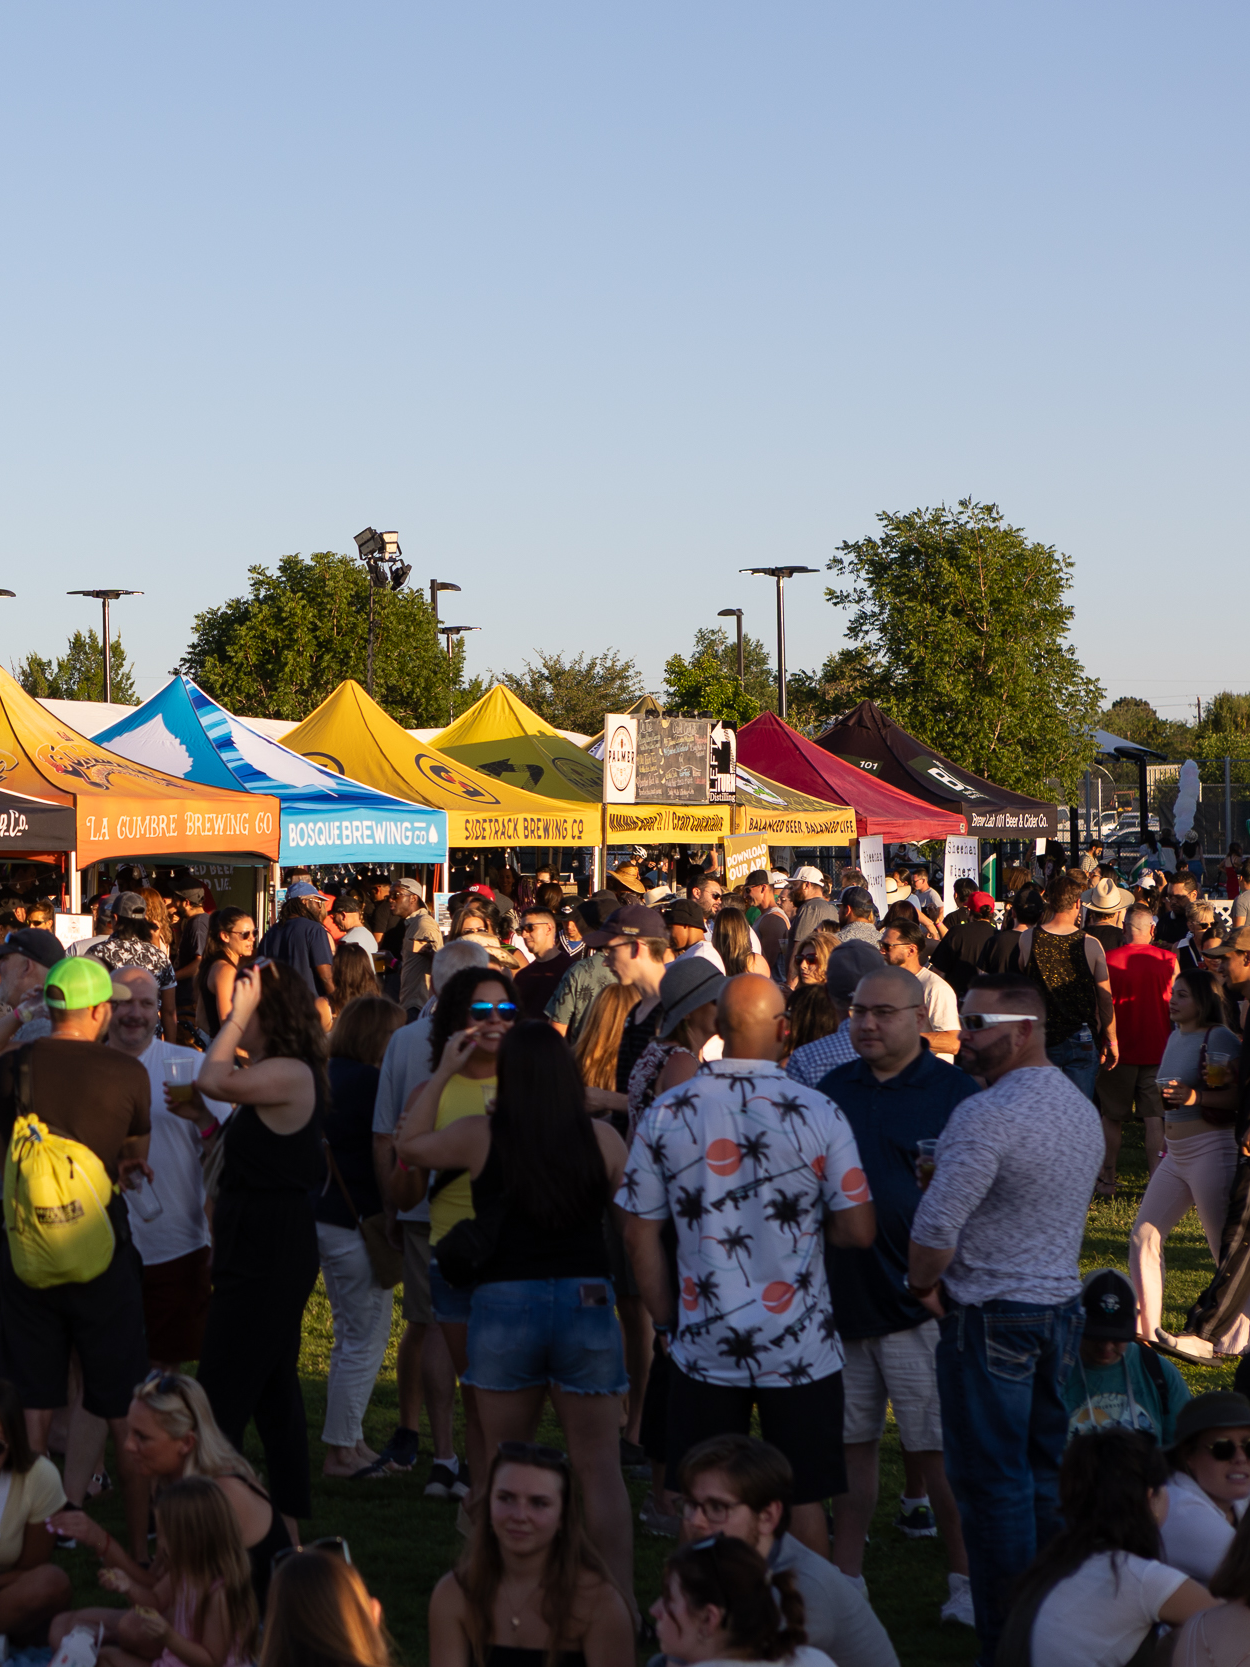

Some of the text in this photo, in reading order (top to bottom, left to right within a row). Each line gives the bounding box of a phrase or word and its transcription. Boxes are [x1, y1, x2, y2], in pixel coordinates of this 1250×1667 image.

[608, 750, 635, 764] PALMER
[859, 760, 878, 770] 101
[717, 773, 736, 793] TURN
[710, 793, 736, 803] Distilling
[8, 809, 29, 838] Co.
[464, 818, 520, 840] SIDETRACK
[522, 817, 568, 840] BREWING
[749, 817, 785, 832] BALANCED
[805, 821, 840, 835] BALANCED
[840, 820, 856, 833] LIFE.
[971, 812, 1049, 828] Brew Lab 101 Beer & Cider Co.
[727, 843, 767, 868] DOWNLOAD
[729, 864, 750, 881] OUR
[749, 856, 767, 873] APP
